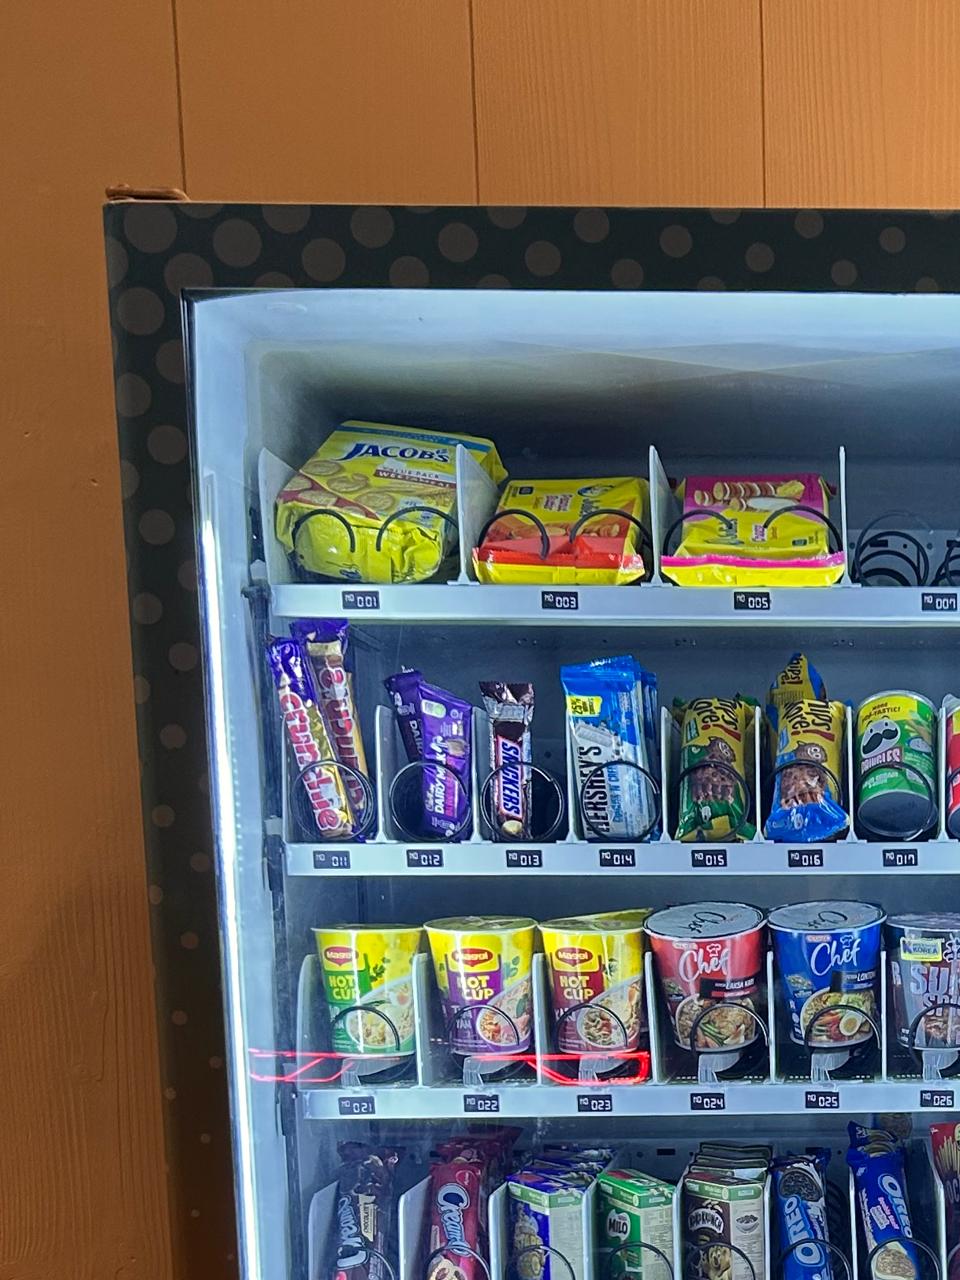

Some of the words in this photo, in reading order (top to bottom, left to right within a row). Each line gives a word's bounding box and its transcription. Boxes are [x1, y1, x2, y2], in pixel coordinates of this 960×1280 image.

[357, 596, 376, 607] 001
[556, 597, 576, 608] 003
[748, 598, 768, 608] 005
[332, 856, 346, 866] 011
[421, 855, 439, 865] 012
[520, 855, 539, 865] 013
[614, 855, 632, 864] 014
[706, 855, 724, 865] 015
[802, 855, 820, 865] 016
[810, 938, 861, 976] Chef
[678, 945, 732, 983] Chef
[328, 976, 356, 989] HOT
[559, 976, 590, 989] HOT
[462, 988, 496, 1000] CUP
[563, 988, 595, 1001] CUP
[478, 1100, 497, 1110] 022
[592, 1100, 610, 1110] 023
[704, 1098, 723, 1108] 024
[819, 1097, 837, 1106] 025
[934, 1096, 952, 1105] 026
[353, 1103, 372, 1112] 021
[878, 1174, 914, 1239] OREO
[608, 1218, 628, 1235] MILO
[784, 1195, 826, 1266] OREO
